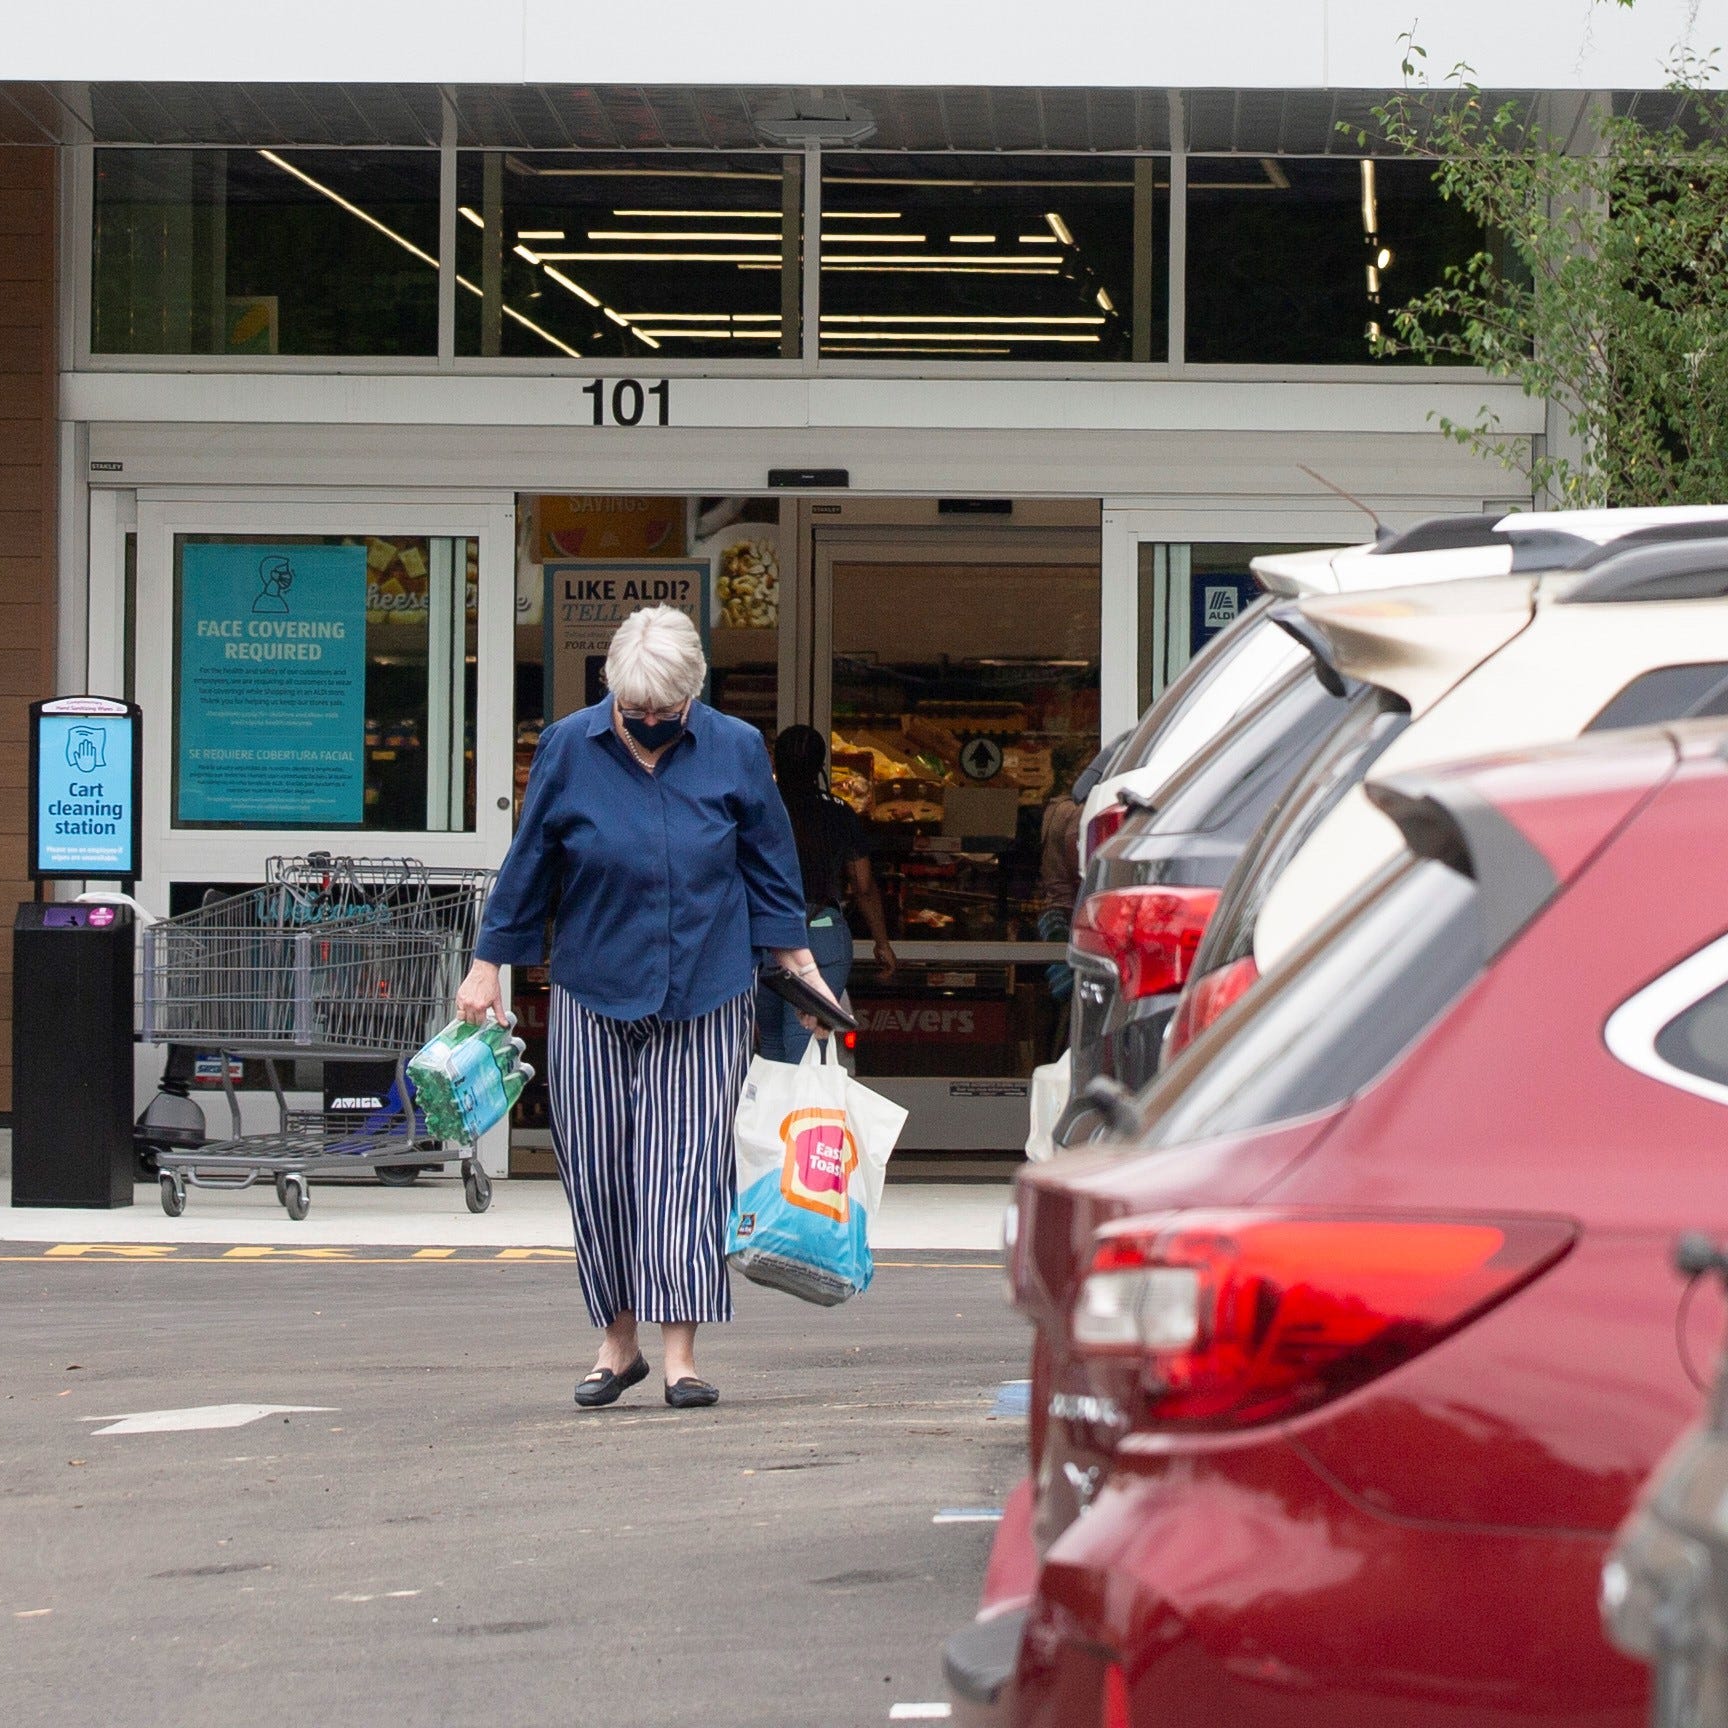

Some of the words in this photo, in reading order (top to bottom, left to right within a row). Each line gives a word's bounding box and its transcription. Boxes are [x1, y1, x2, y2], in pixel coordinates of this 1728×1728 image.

[582, 379, 671, 426] 101
[564, 580, 615, 600] LIKE
[623, 580, 690, 600] ALDI?
[562, 603, 622, 622] TELL
[1208, 612, 1235, 620] ALDI
[196, 620, 243, 638] FACE
[248, 621, 346, 639] COVERING
[224, 642, 322, 662] REQUIRED
[188, 748, 201, 759] SE
[203, 749, 254, 761] REQUIERE
[256, 750, 318, 761] COBERTURA
[320, 750, 354, 761] FACIAL
[69, 782, 104, 797] Cart
[48, 800, 123, 820] cleaning
[55, 819, 116, 835] station
[815, 1141, 842, 1161] Eas
[810, 1154, 842, 1177] Toas
